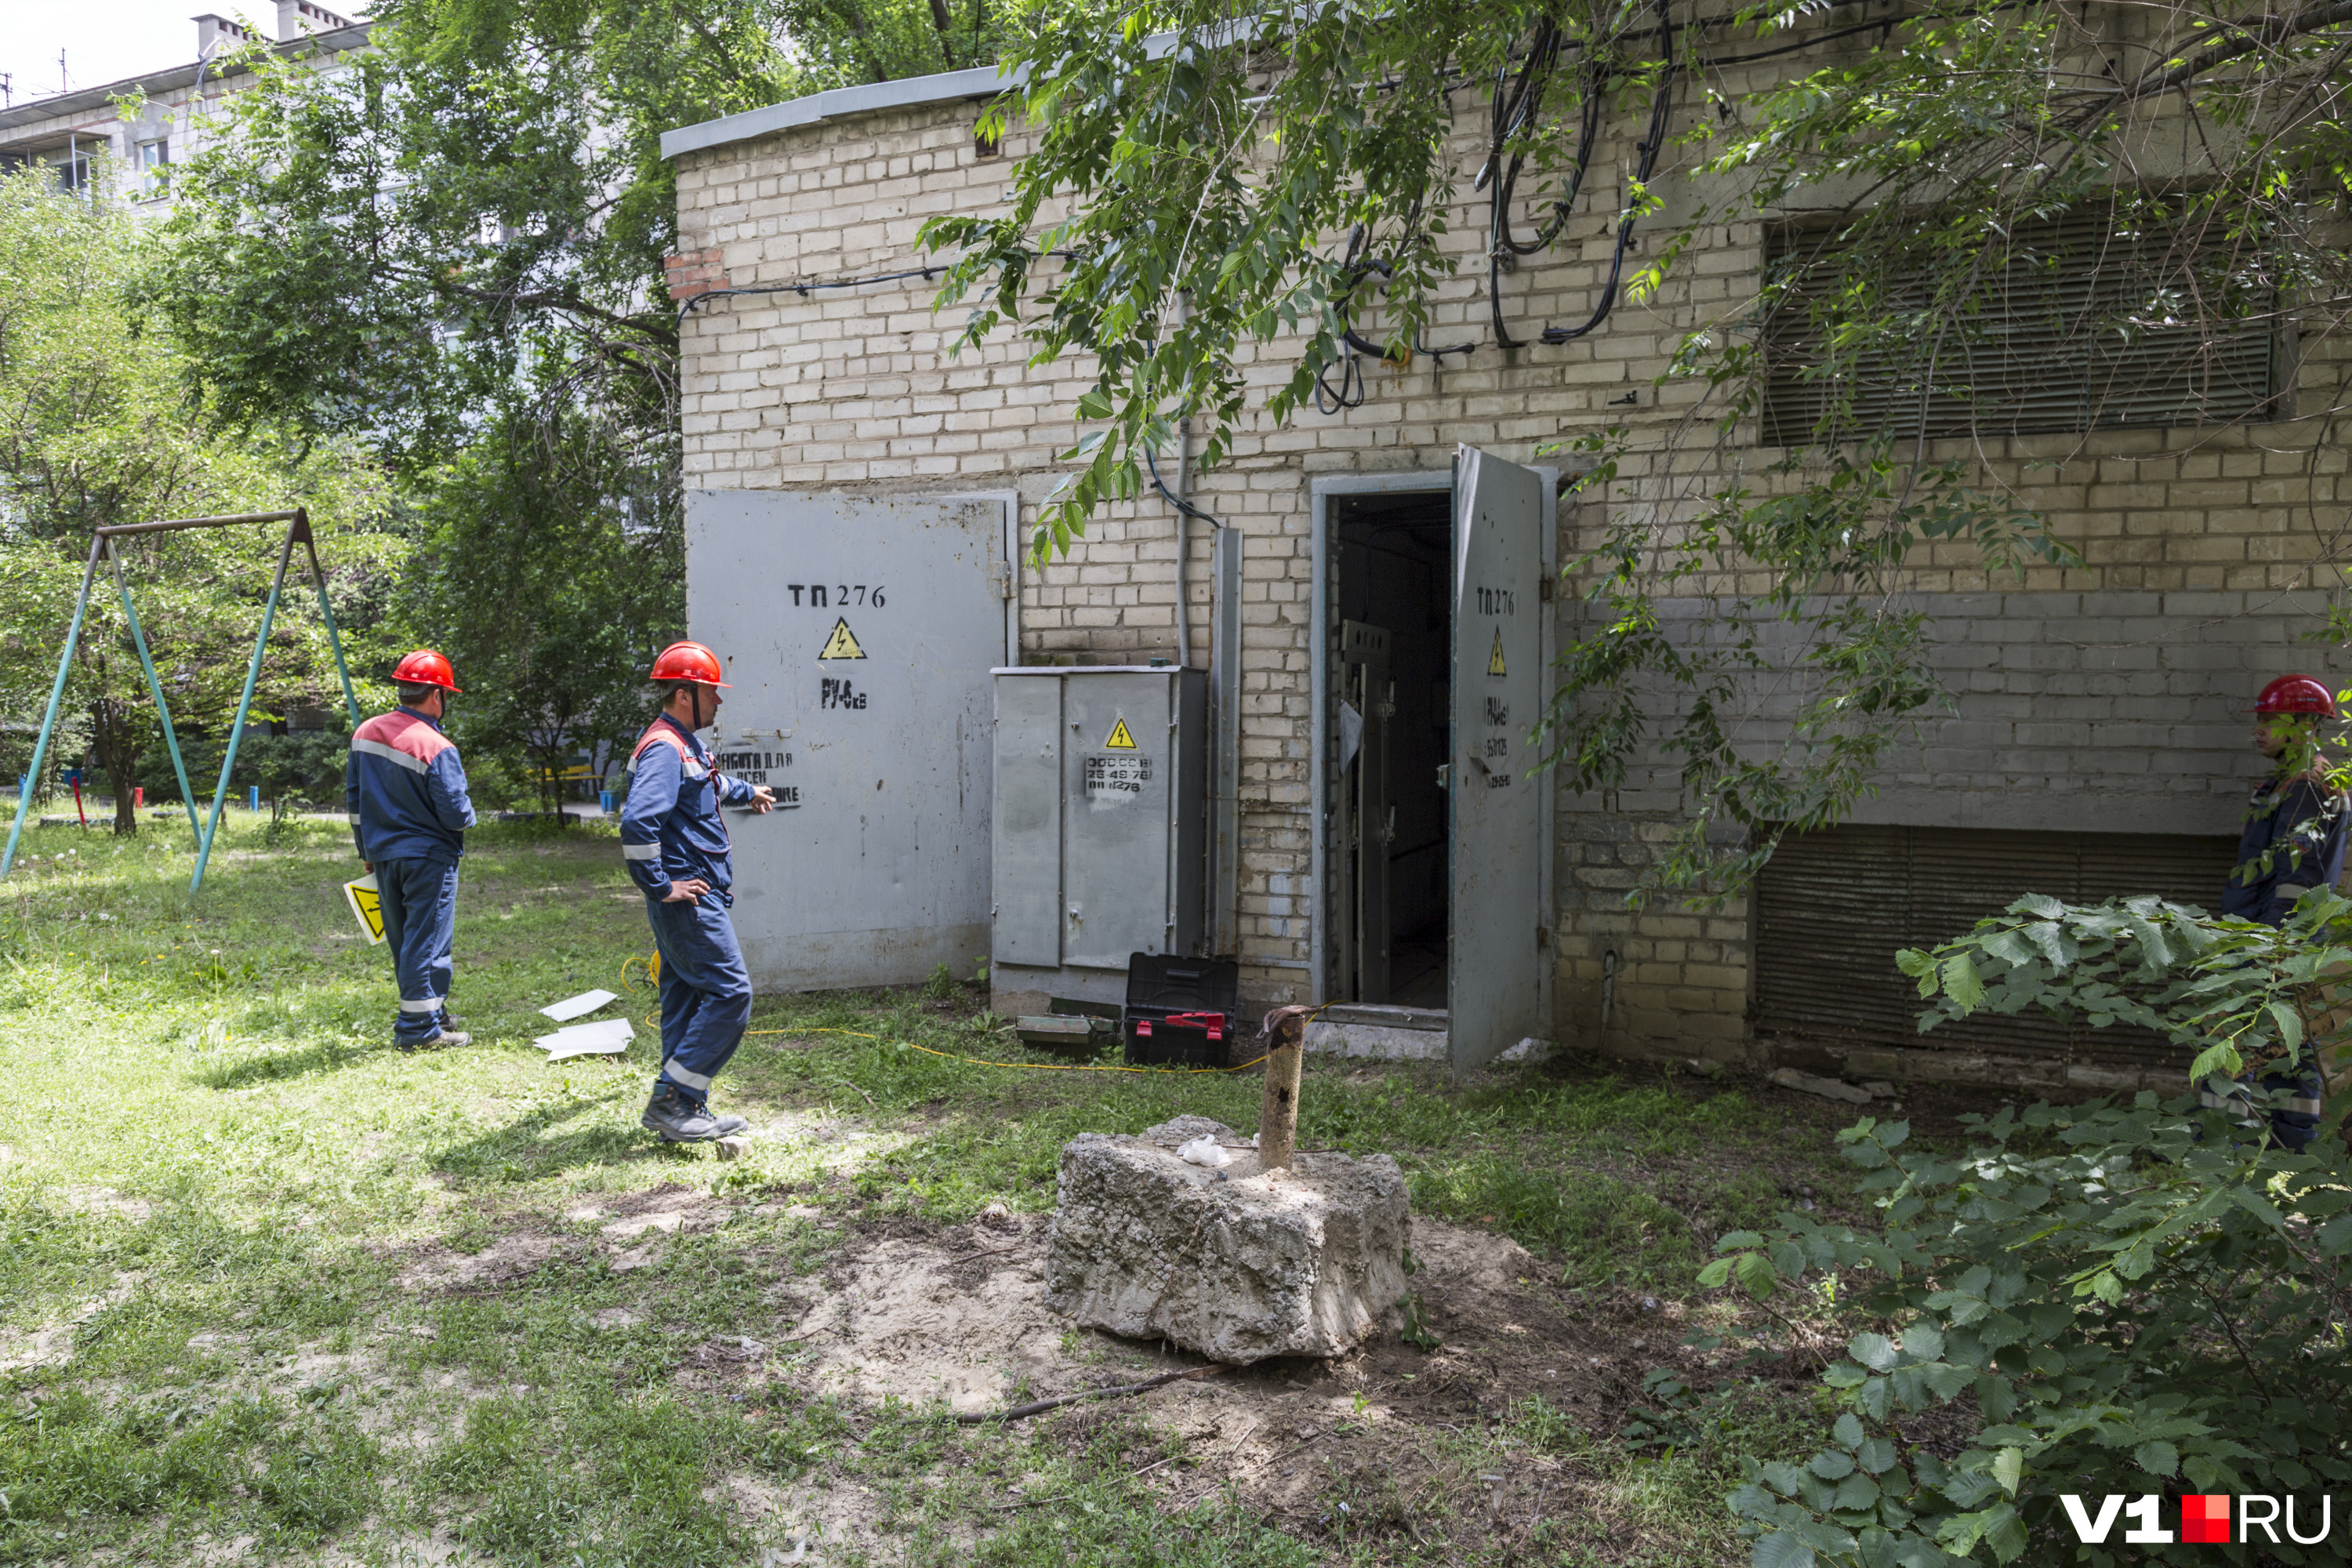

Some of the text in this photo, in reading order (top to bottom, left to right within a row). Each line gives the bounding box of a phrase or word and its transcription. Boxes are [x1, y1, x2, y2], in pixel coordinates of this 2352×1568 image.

[787, 584, 886, 608] ТП 276
[1477, 586, 1515, 616] ТП 276
[764, 752, 793, 769] ДЛЯ
